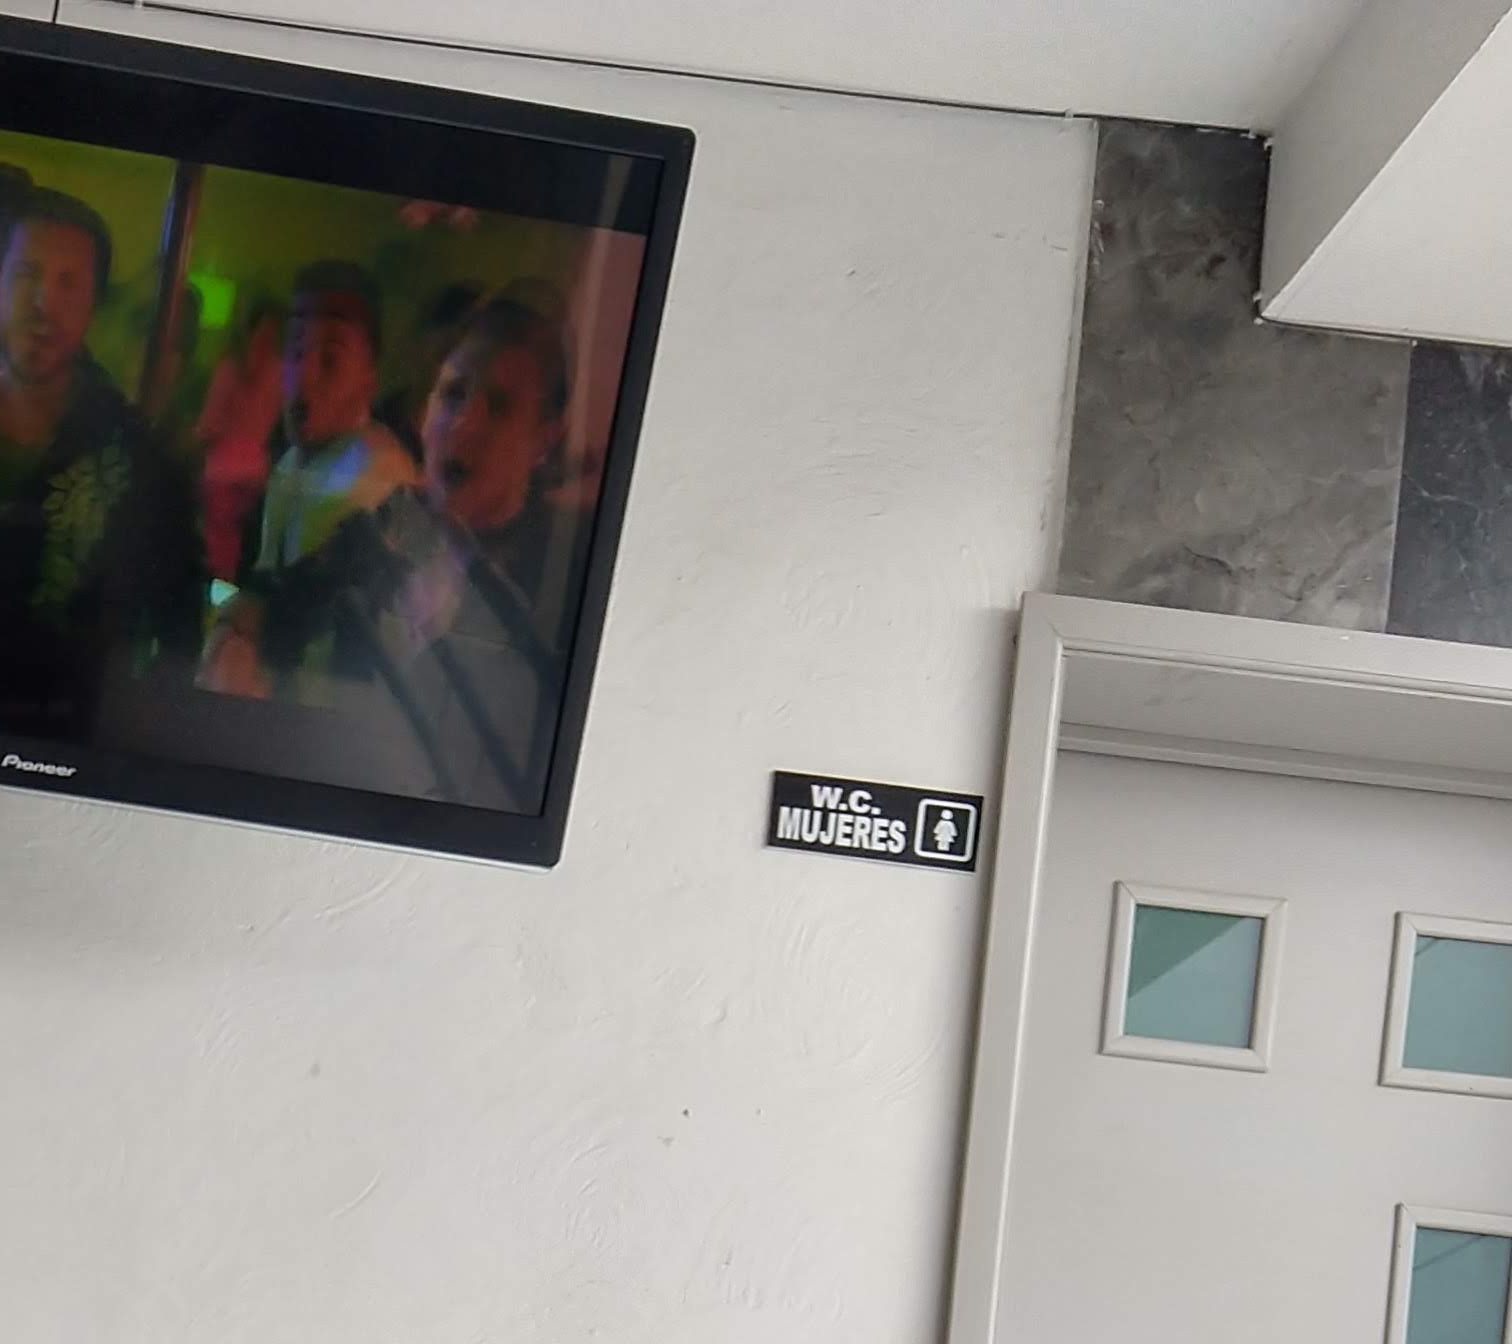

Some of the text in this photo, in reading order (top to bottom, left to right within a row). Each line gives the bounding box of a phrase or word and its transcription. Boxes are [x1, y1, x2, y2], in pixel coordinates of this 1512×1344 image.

[0, 754, 77, 777] Pioneer
[810, 784, 882, 816] W.C.
[776, 806, 907, 854] MUJERES
